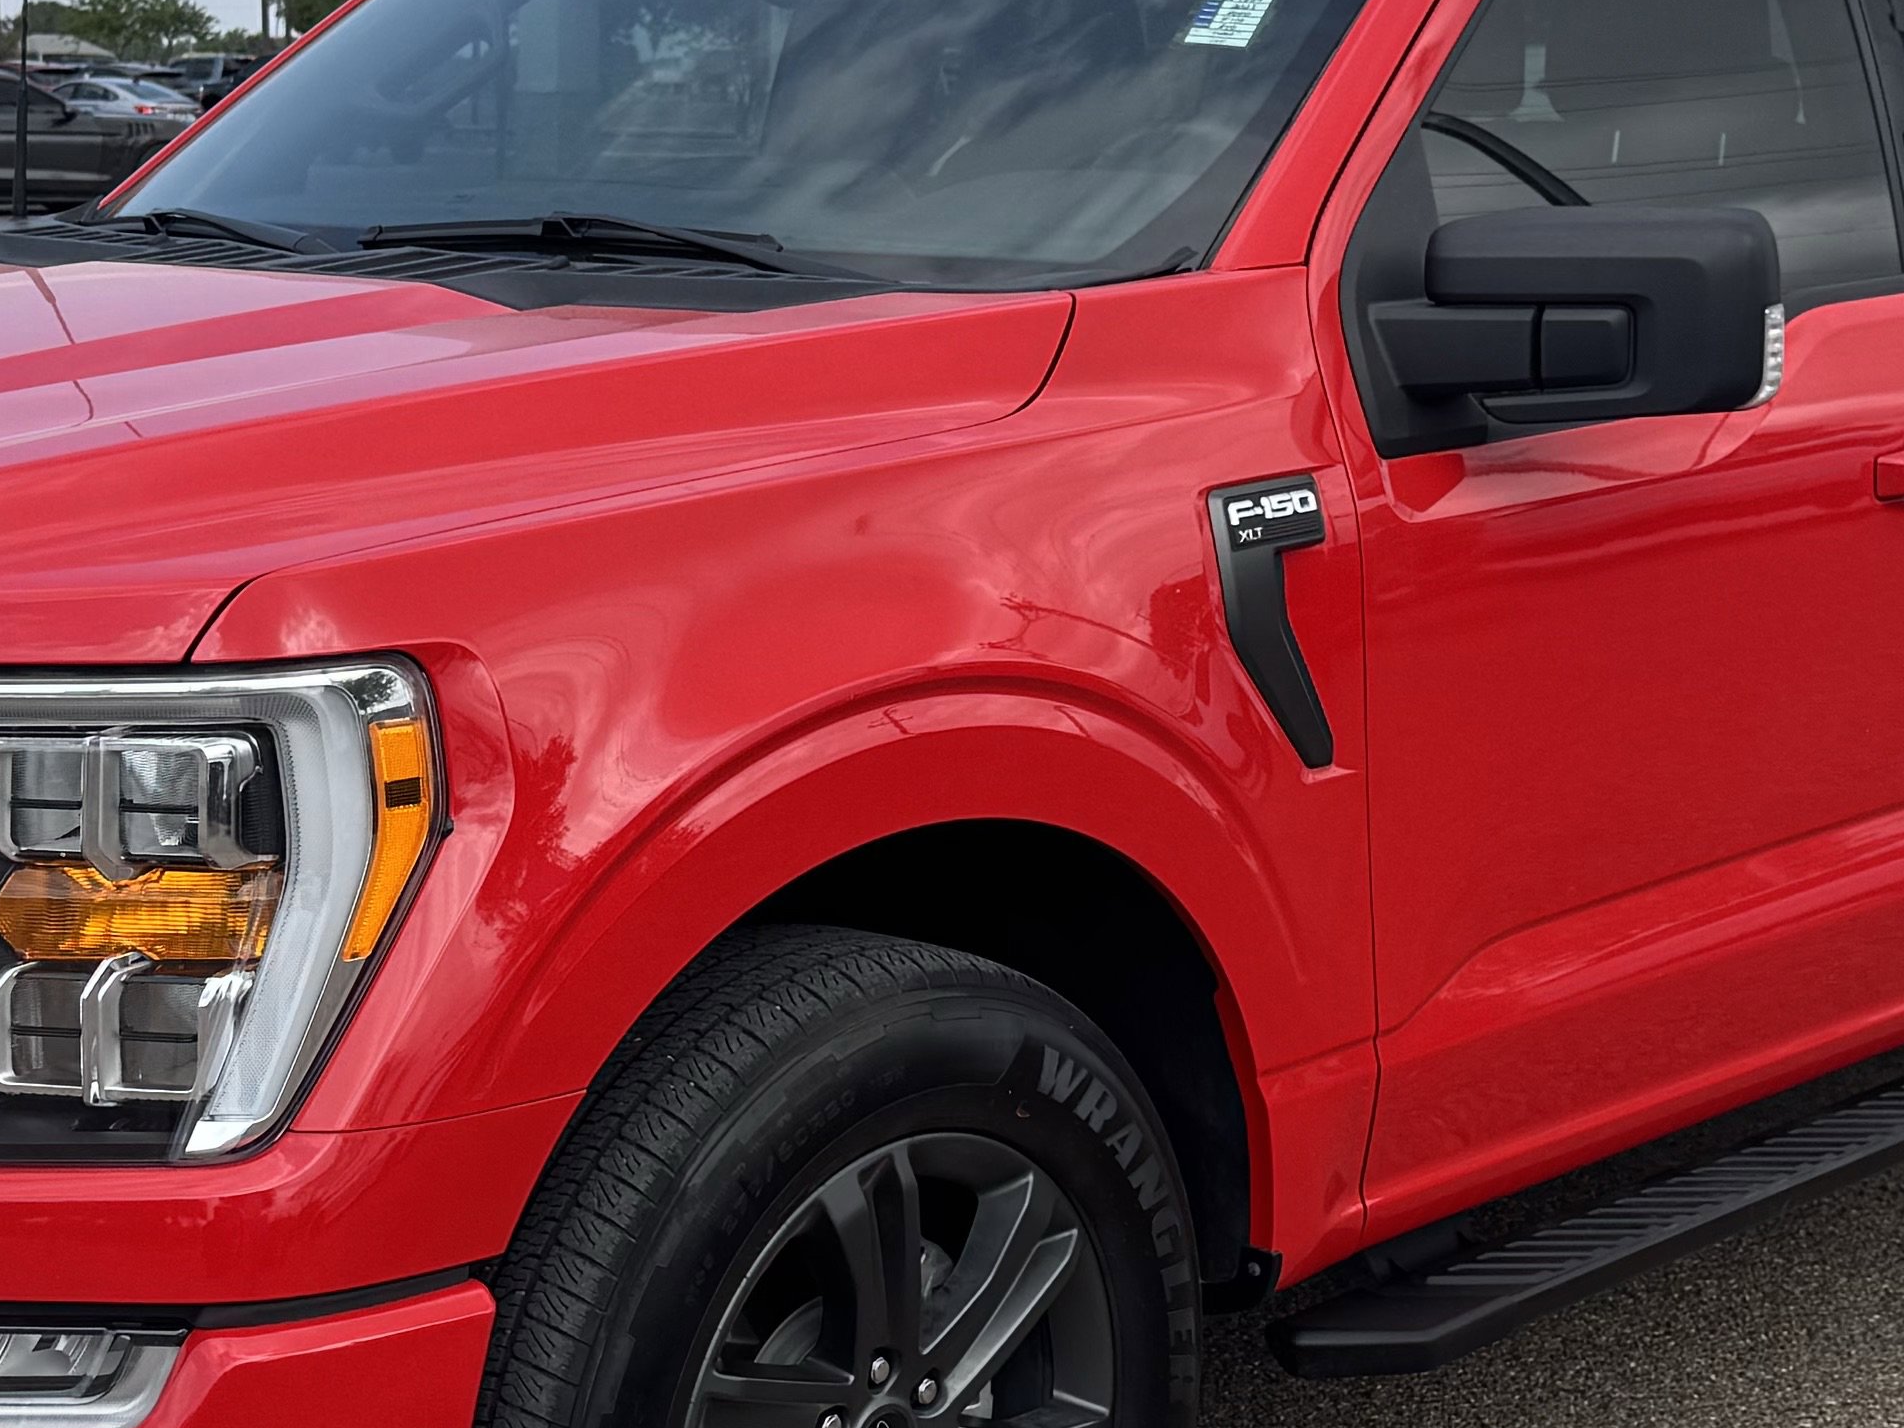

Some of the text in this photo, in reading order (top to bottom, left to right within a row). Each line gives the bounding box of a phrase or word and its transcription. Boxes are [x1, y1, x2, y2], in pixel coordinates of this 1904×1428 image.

[1226, 487, 1318, 527] F-150
[1238, 526, 1264, 544] XLT
[1035, 1043, 1200, 1404] WRANGLER
